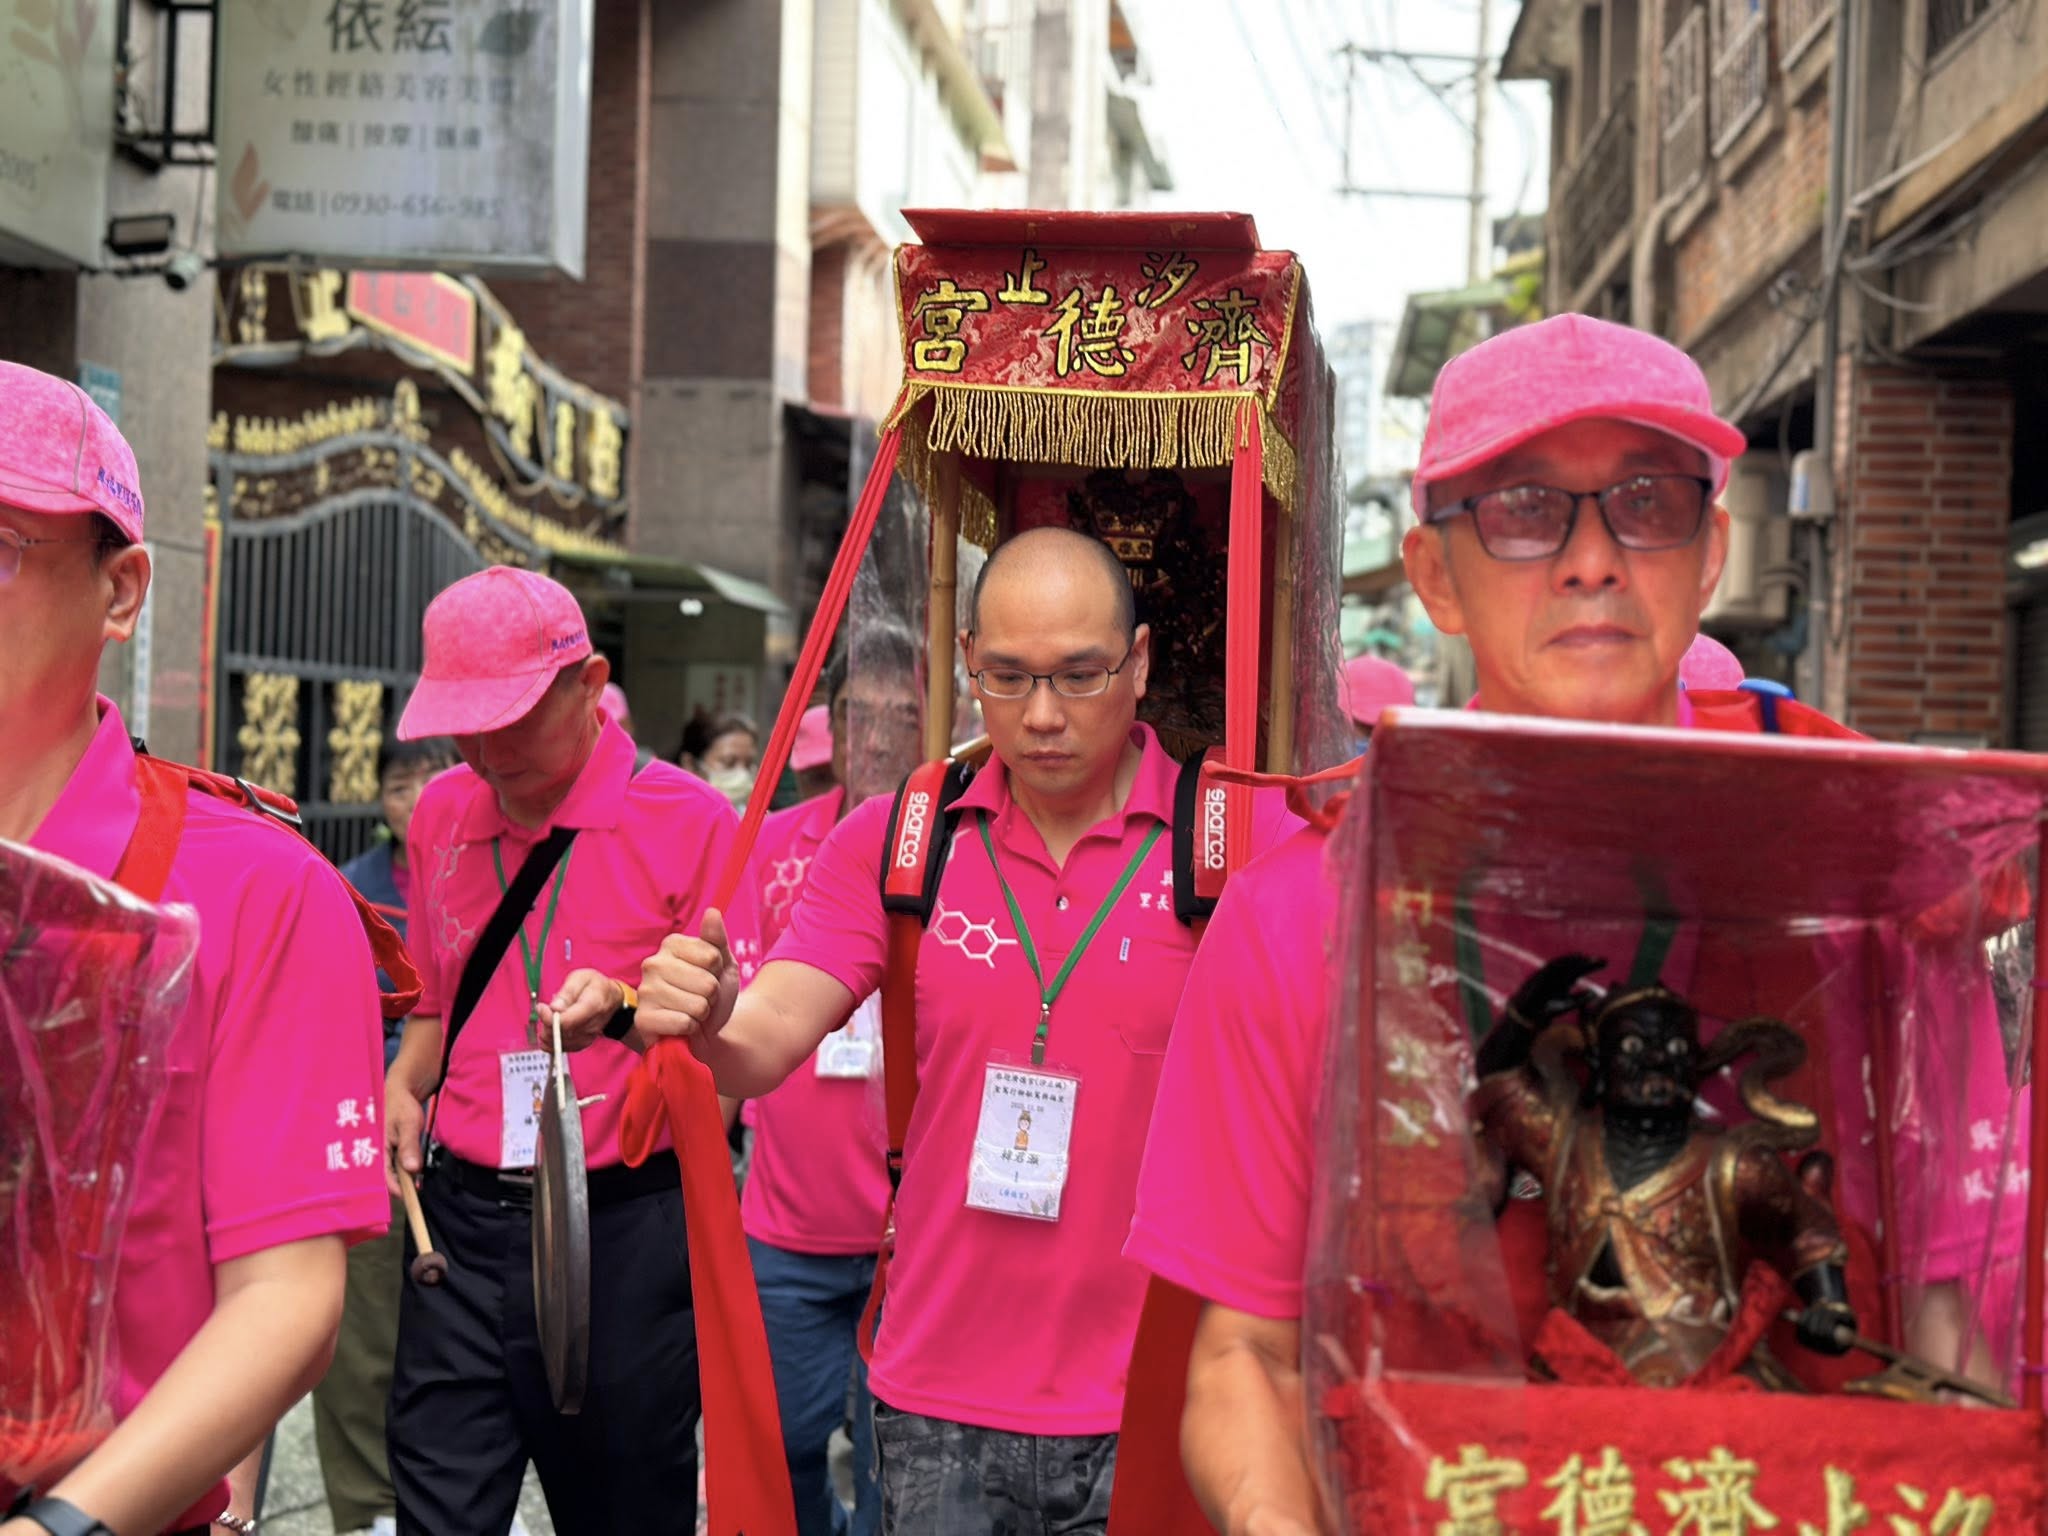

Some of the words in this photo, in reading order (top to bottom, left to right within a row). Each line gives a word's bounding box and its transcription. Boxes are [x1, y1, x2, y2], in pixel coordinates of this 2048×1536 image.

[895, 791, 930, 869] sparco
[1205, 788, 1236, 870] sparco
[326, 1137, 379, 1171] 服務
